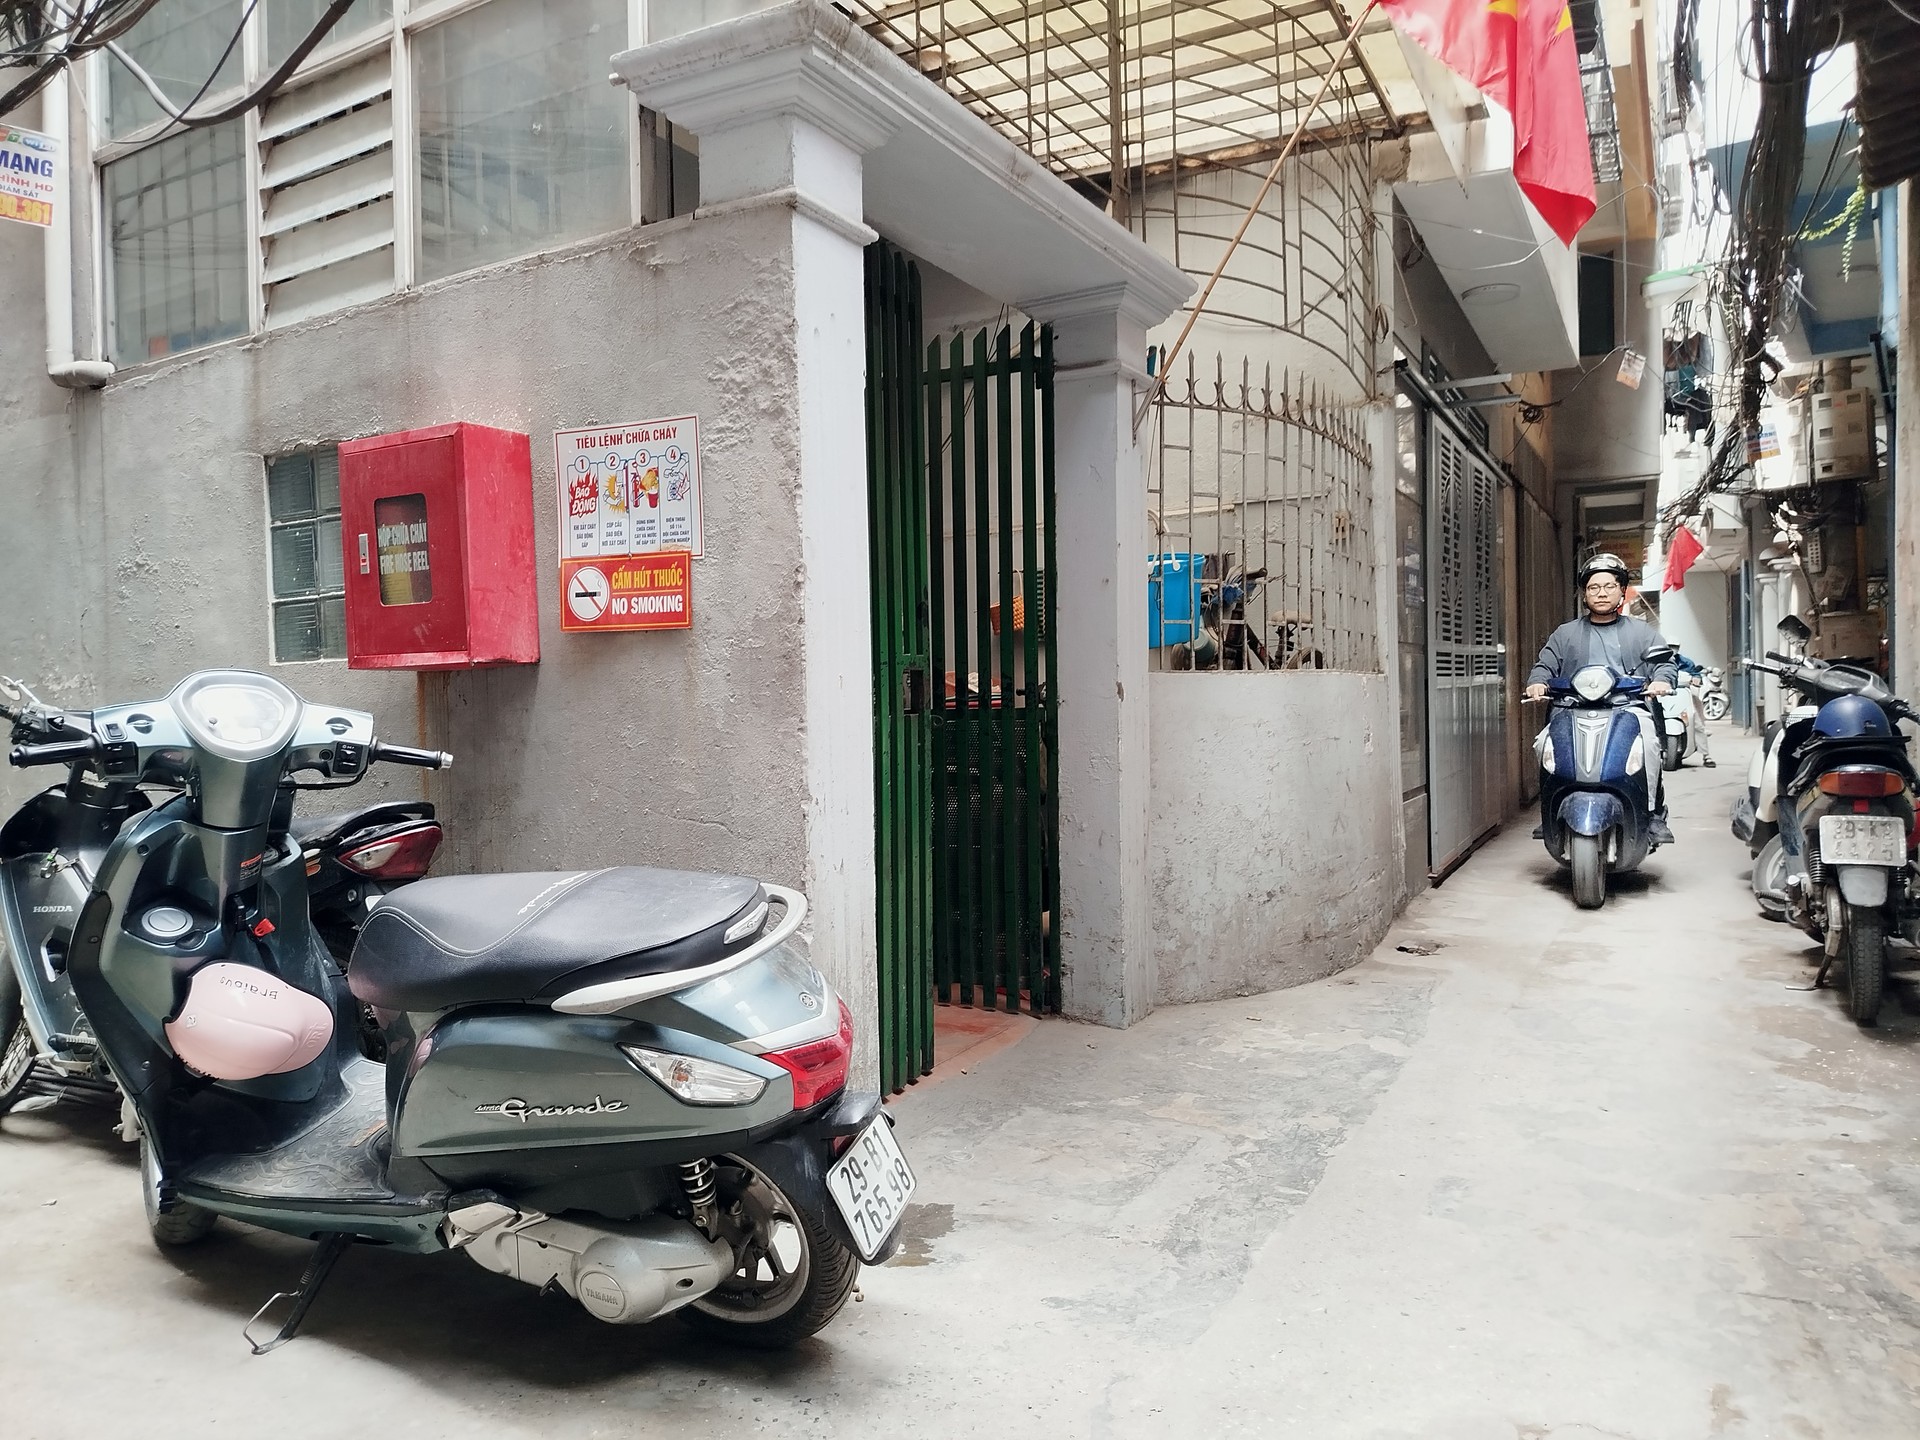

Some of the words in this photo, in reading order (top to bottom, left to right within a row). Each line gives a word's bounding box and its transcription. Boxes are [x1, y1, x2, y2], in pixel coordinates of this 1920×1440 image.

[23, 189, 39, 198] SÁT
[35, 182, 54, 192] HD
[576, 434, 596, 449] TIÊU
[600, 433, 623, 449] LỆNH
[626, 429, 650, 444] CHỮA
[653, 425, 677, 440] CHÁY
[609, 456, 616, 467] 2
[640, 453, 646, 464] 3
[670, 449, 677, 460] 4
[580, 459, 585, 470] 1
[574, 485, 591, 498] BÁO
[380, 554, 394, 575] FIRE
[395, 552, 412, 573] HOSE
[413, 550, 430, 571] REEL
[612, 565, 632, 590] CẤM
[634, 566, 651, 588] HÚT
[654, 562, 683, 587] THUỐC
[612, 598, 628, 615] NO
[631, 595, 683, 614] SMOKING
[33, 905, 74, 913] HONDA
[500, 1094, 629, 1123] Grande
[840, 1126, 891, 1205] 29-B1
[853, 1157, 911, 1249] 765.98
[585, 1287, 619, 1306] YAMAHA
